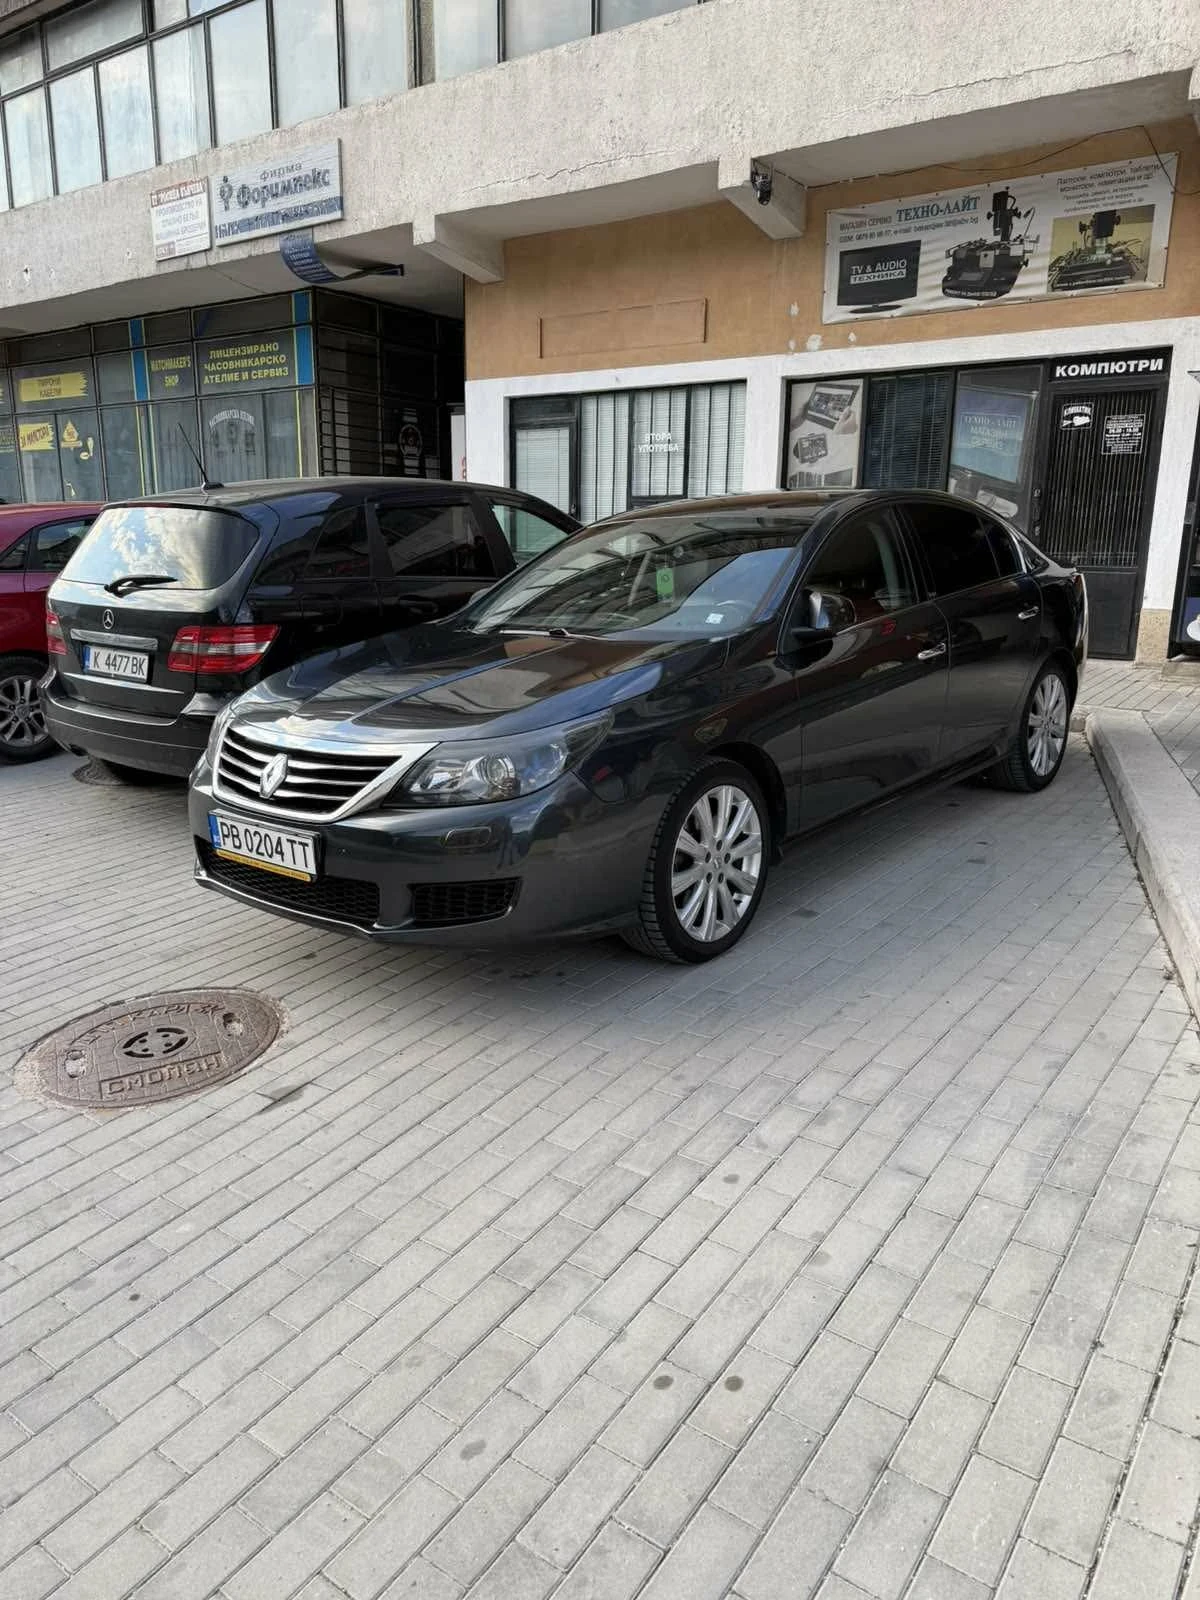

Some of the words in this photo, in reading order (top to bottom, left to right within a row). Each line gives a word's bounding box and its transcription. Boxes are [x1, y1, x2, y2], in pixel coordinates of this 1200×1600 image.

[896, 195, 980, 222] ТЕХНО-ЛАЙТ
[852, 265, 863, 274] TV
[866, 265, 872, 273] &
[875, 259, 907, 271] AUDIO
[852, 271, 905, 283] ТЕХНИКА
[209, 342, 279, 359] ЛИЦЕНЗИРАНО
[204, 355, 286, 371] ЧАСОВНИКАРСКО
[1056, 359, 1164, 377] КОМПЮТРИ
[203, 372, 239, 384] АТЕЛИЕ
[242, 371, 249, 380] И
[251, 367, 289, 380] СЕРВИЗ
[645, 433, 672, 442] ВТОРА
[638, 444, 679, 453] УПОТРЕБА
[94, 651, 101, 668] K
[105, 653, 130, 673] 4477
[131, 657, 146, 676] BK
[219, 822, 242, 849] PB
[244, 829, 285, 862] 0204
[287, 838, 309, 868] TT
